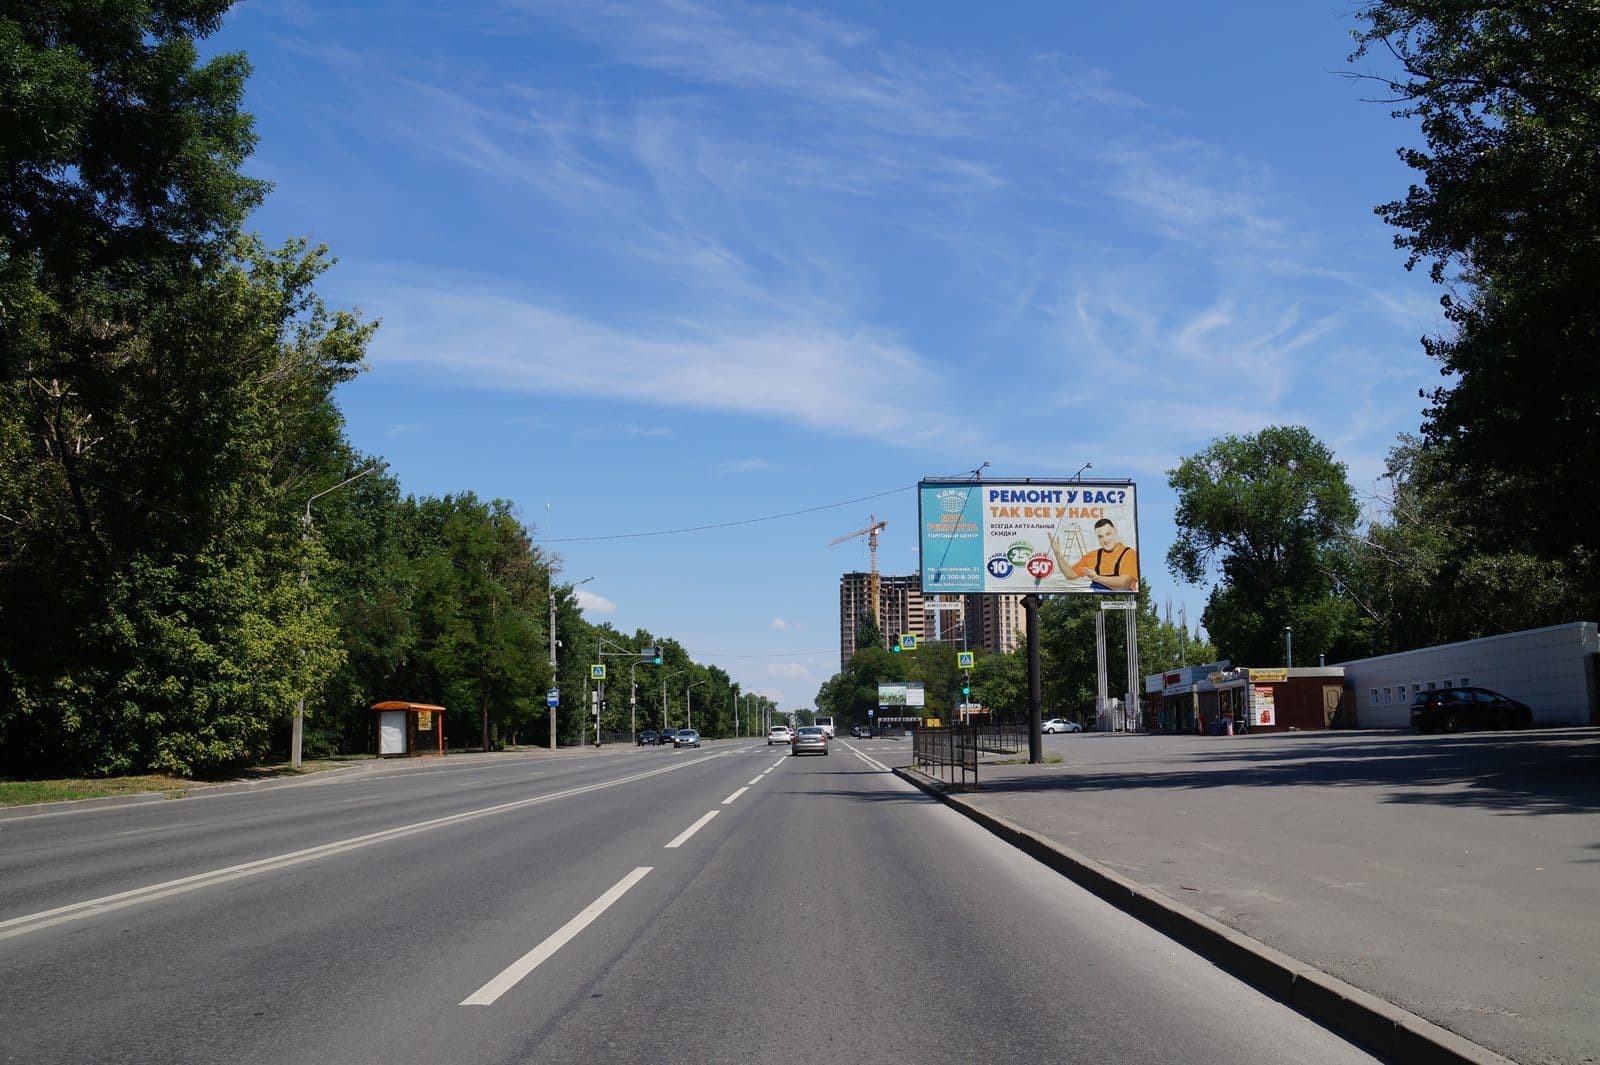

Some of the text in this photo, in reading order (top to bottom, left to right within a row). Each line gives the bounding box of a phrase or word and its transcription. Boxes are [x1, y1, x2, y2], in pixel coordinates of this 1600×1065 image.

[989, 490, 1126, 504] РЕМОНТ У ВАС?
[990, 506, 1105, 519] ТАК ВСЕ У НАС!
